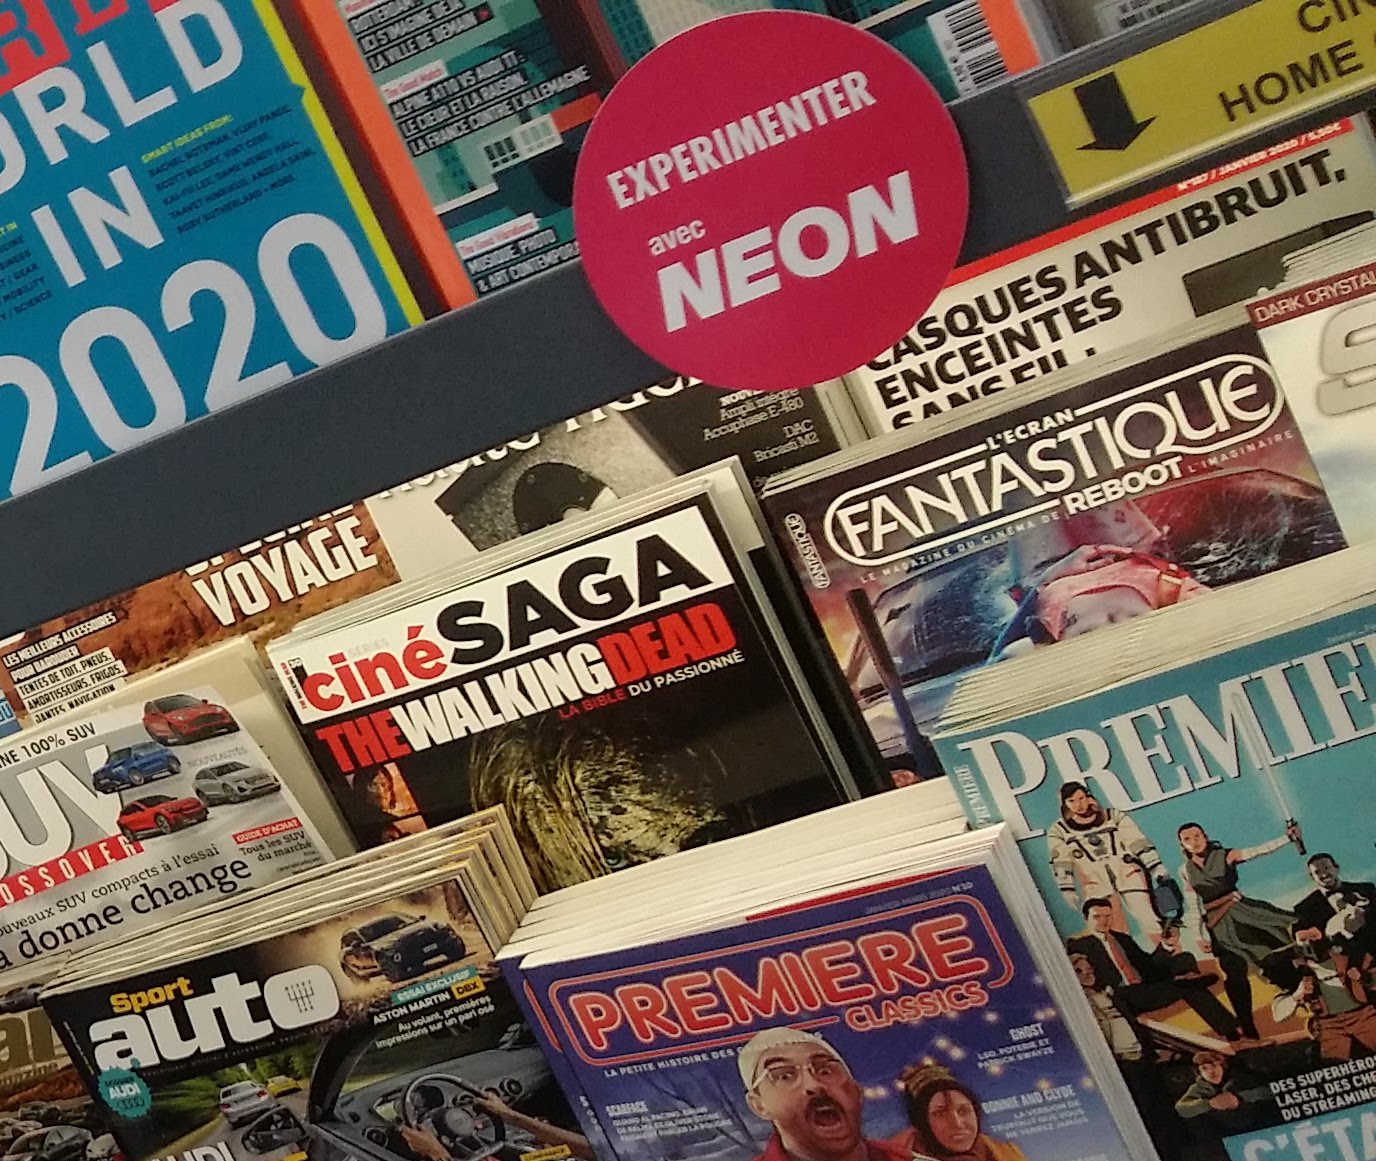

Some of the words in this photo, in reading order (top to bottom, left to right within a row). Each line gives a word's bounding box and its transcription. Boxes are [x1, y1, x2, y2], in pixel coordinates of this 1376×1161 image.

[1218, 53, 1363, 121] HOME
[606, 69, 877, 211] EXPERIMENTER
[32, 166, 164, 288] IN
[648, 217, 708, 257] avec
[657, 170, 920, 334] NEON
[876, 286, 1124, 408] ENCEINTES
[986, 407, 1076, 451] L'ECRAN
[833, 369, 1283, 559] FANTASTIQUE
[1065, 456, 1186, 515] REBOOT
[192, 513, 379, 628] VOYAGE
[653, 648, 746, 691] PASSIONNÉ
[21, 734, 66, 758] 100%
[67, 722, 97, 744] SUV
[56, 891, 88, 912] SUV
[91, 867, 160, 899] compacts
[175, 844, 220, 870] l'essai
[239, 844, 265, 857] Tous
[284, 831, 306, 845] SUV
[17, 902, 124, 960] donne
[130, 859, 251, 914] change
[110, 976, 194, 1016] Sport
[373, 1006, 409, 1025] ASTON
[410, 992, 451, 1016] MARTIN
[567, 915, 988, 1051] PREMIERE
[846, 981, 990, 1031] CLASSICS
[88, 964, 339, 1071] auto
[619, 1059, 655, 1077] PETITE
[657, 1049, 708, 1071] HISTOIRE
